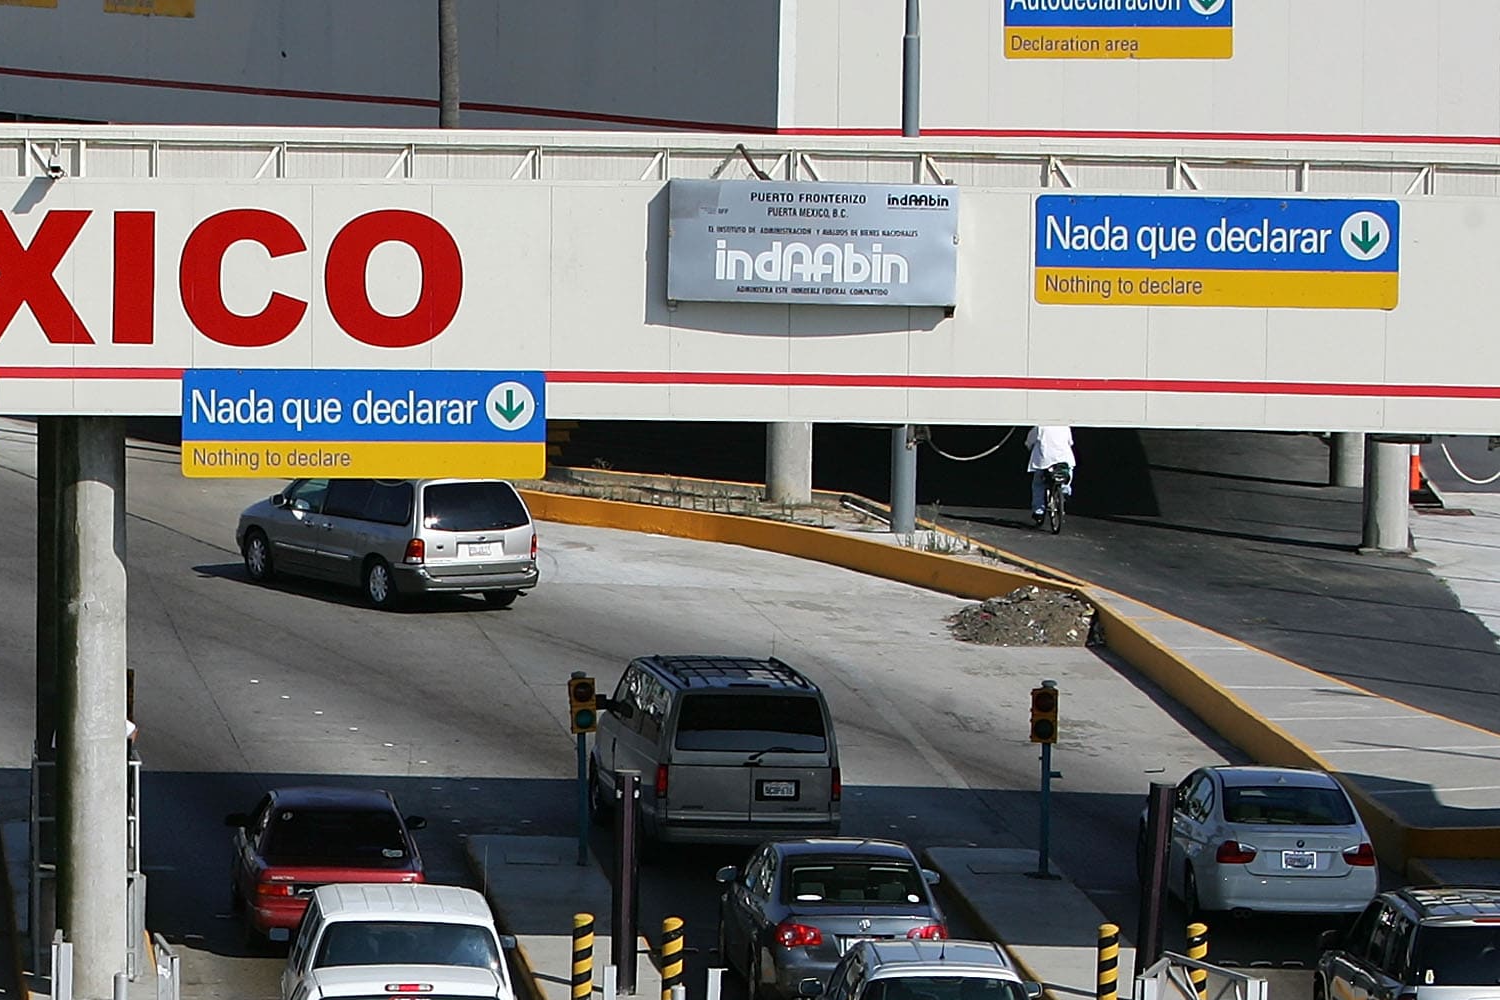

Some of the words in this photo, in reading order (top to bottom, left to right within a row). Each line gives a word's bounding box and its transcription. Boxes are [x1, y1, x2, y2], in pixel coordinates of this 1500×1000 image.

[1011, 35, 1100, 51] Declaration
[1105, 39, 1139, 51] area
[750, 192, 794, 203] PUERTO
[799, 193, 866, 204] FRONTERIZO
[767, 207, 797, 217] PUERTA
[832, 209, 848, 218] B.C.
[1046, 215, 1128, 251] Nada
[1136, 225, 1196, 260] que
[1206, 217, 1332, 254] declarar
[1045, 275, 1112, 299] Nothing
[1117, 277, 1134, 295] to
[1138, 276, 1203, 295] declare
[192, 389, 274, 425] Nada
[282, 398, 342, 433] que
[352, 390, 479, 426] declarar
[193, 448, 260, 471] Nothing
[265, 449, 282, 467] to
[286, 448, 352, 467] declare
